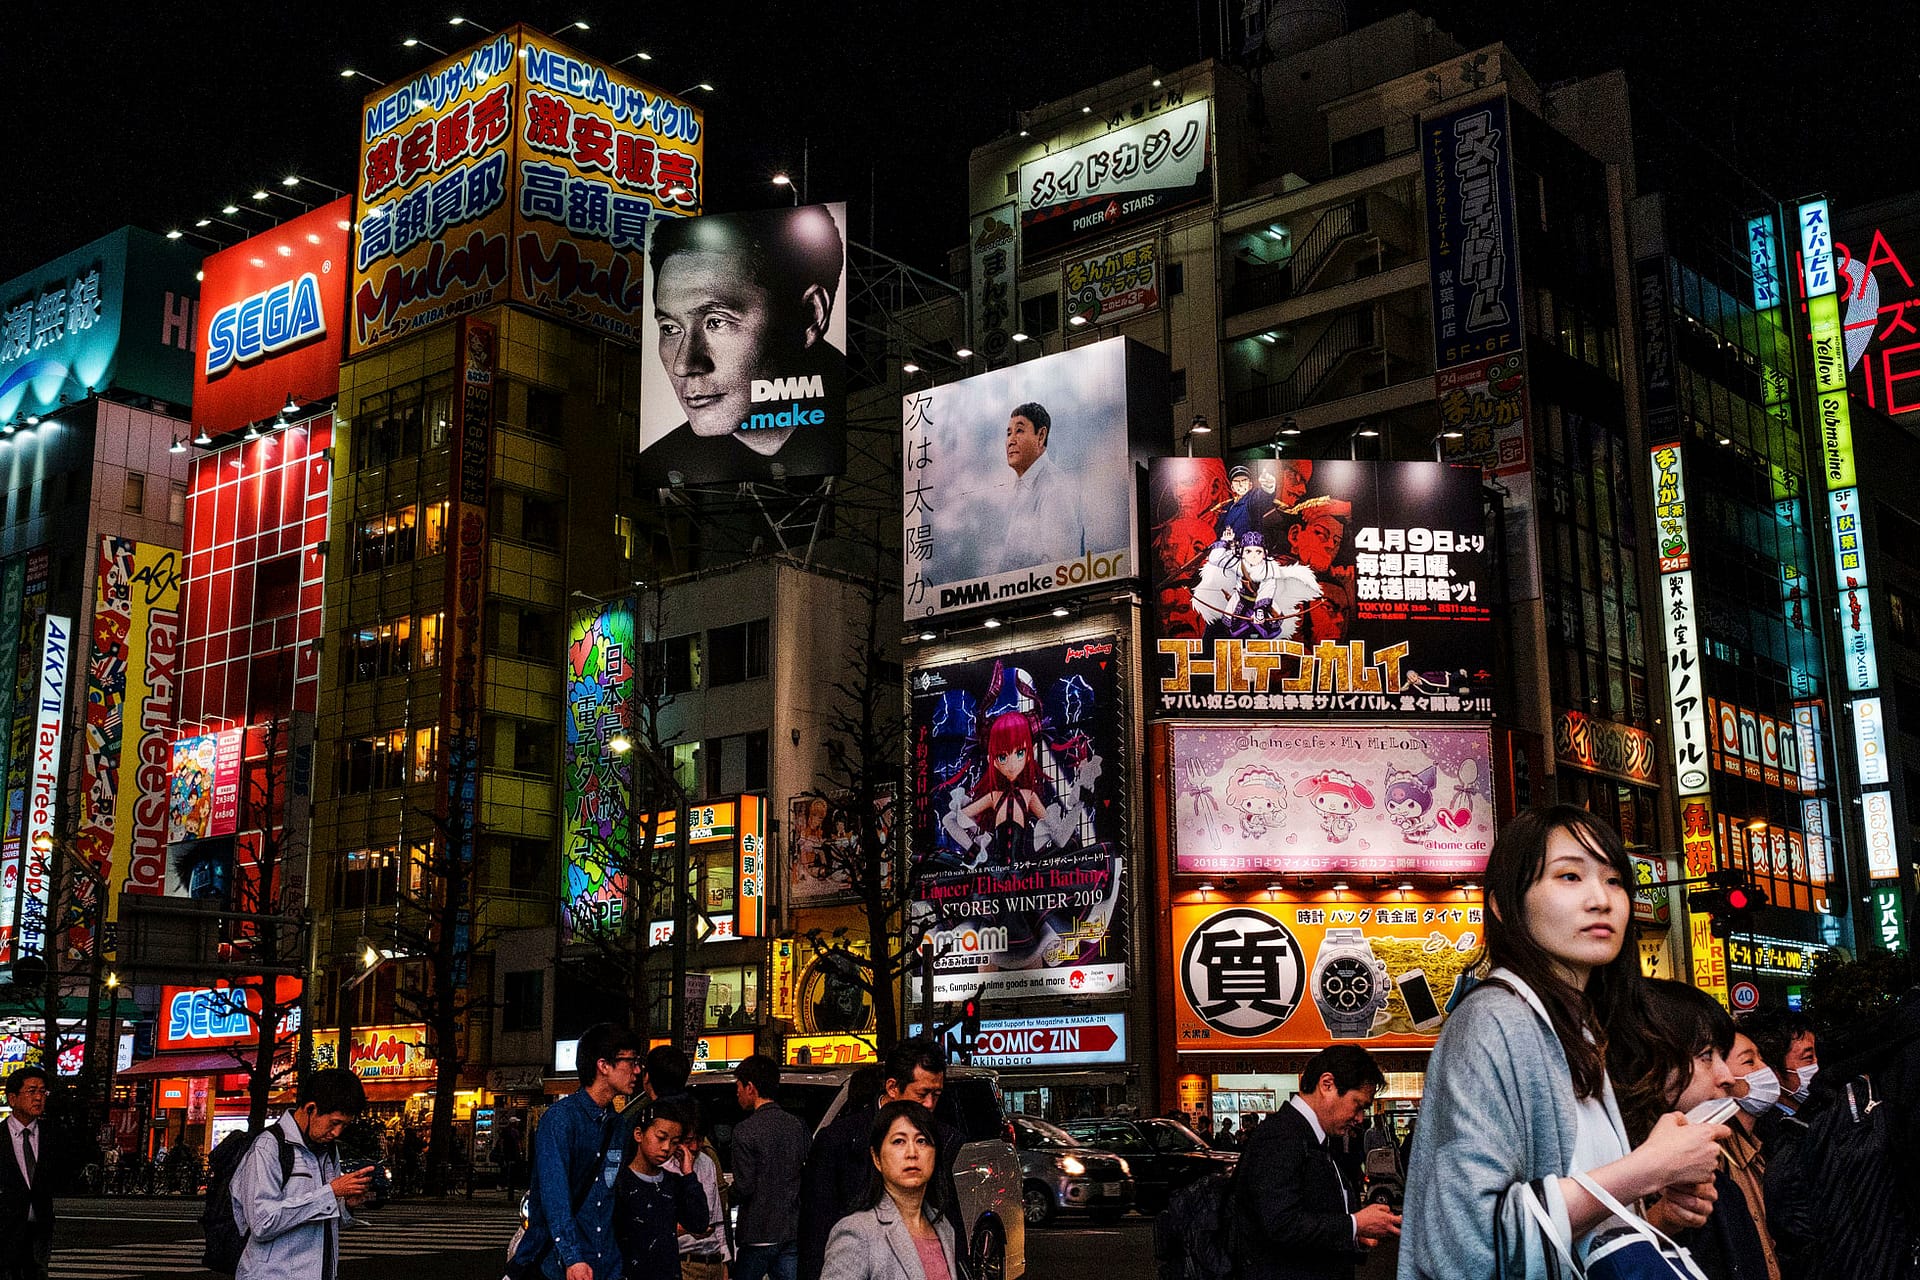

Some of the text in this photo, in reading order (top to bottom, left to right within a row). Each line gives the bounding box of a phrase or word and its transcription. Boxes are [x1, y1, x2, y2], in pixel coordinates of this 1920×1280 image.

[364, 87, 509, 197] 激安販売
[526, 91, 697, 204] 激安販売
[1030, 120, 1199, 209] メイドカジノ
[359, 153, 505, 270] 高額買取
[522, 163, 686, 250] 高額買
[1073, 194, 1154, 232] POKER STARS
[1067, 244, 1153, 294] まんが喫茶
[1806, 209, 1830, 288] スーパービル
[356, 231, 507, 344] Mulan
[206, 272, 326, 375] SEGA
[1816, 337, 1832, 386] Yellow
[751, 375, 824, 402] DMM
[741, 403, 825, 429] .make
[1822, 399, 1842, 480] Submarine
[1655, 448, 1678, 504] まんが
[1836, 491, 1850, 502] 5F
[905, 393, 934, 616] 次は太陽か。
[1355, 527, 1484, 553] 4月9日より
[1356, 552, 1456, 577] 毎週月曜、
[1055, 551, 1124, 587] solar
[1358, 602, 1392, 612] TOKYO
[1394, 603, 1409, 612] MX
[45, 620, 67, 698] AKKY
[1157, 638, 1409, 694] ゴールデンカムイ
[1669, 575, 1703, 765] 喫茶室ルノアール
[1465, 840, 1486, 850] cafe
[1683, 803, 1715, 876] 免税
[1869, 796, 1890, 864] あみあみ
[743, 833, 756, 897] 吉野家
[977, 872, 1044, 894] Elisabeth
[943, 889, 1104, 918] STORES WINTER 2019
[1298, 911, 1323, 923] 時計
[1331, 910, 1372, 923] バッグ
[1376, 910, 1417, 923] 貴金属
[1424, 910, 1463, 923] ダイヤ
[655, 928, 671, 941] 2F
[1006, 979, 1027, 990] goods
[1030, 978, 1043, 987] and
[1046, 976, 1065, 985] more
[1196, 928, 1295, 1020] 質
[1737, 989, 1753, 1001] 40
[169, 986, 251, 1040] SEGA
[1036, 1017, 1064, 1027] Magazine
[972, 1056, 1032, 1067] Akihabara
[975, 1029, 1080, 1054] COMIC ZIN
